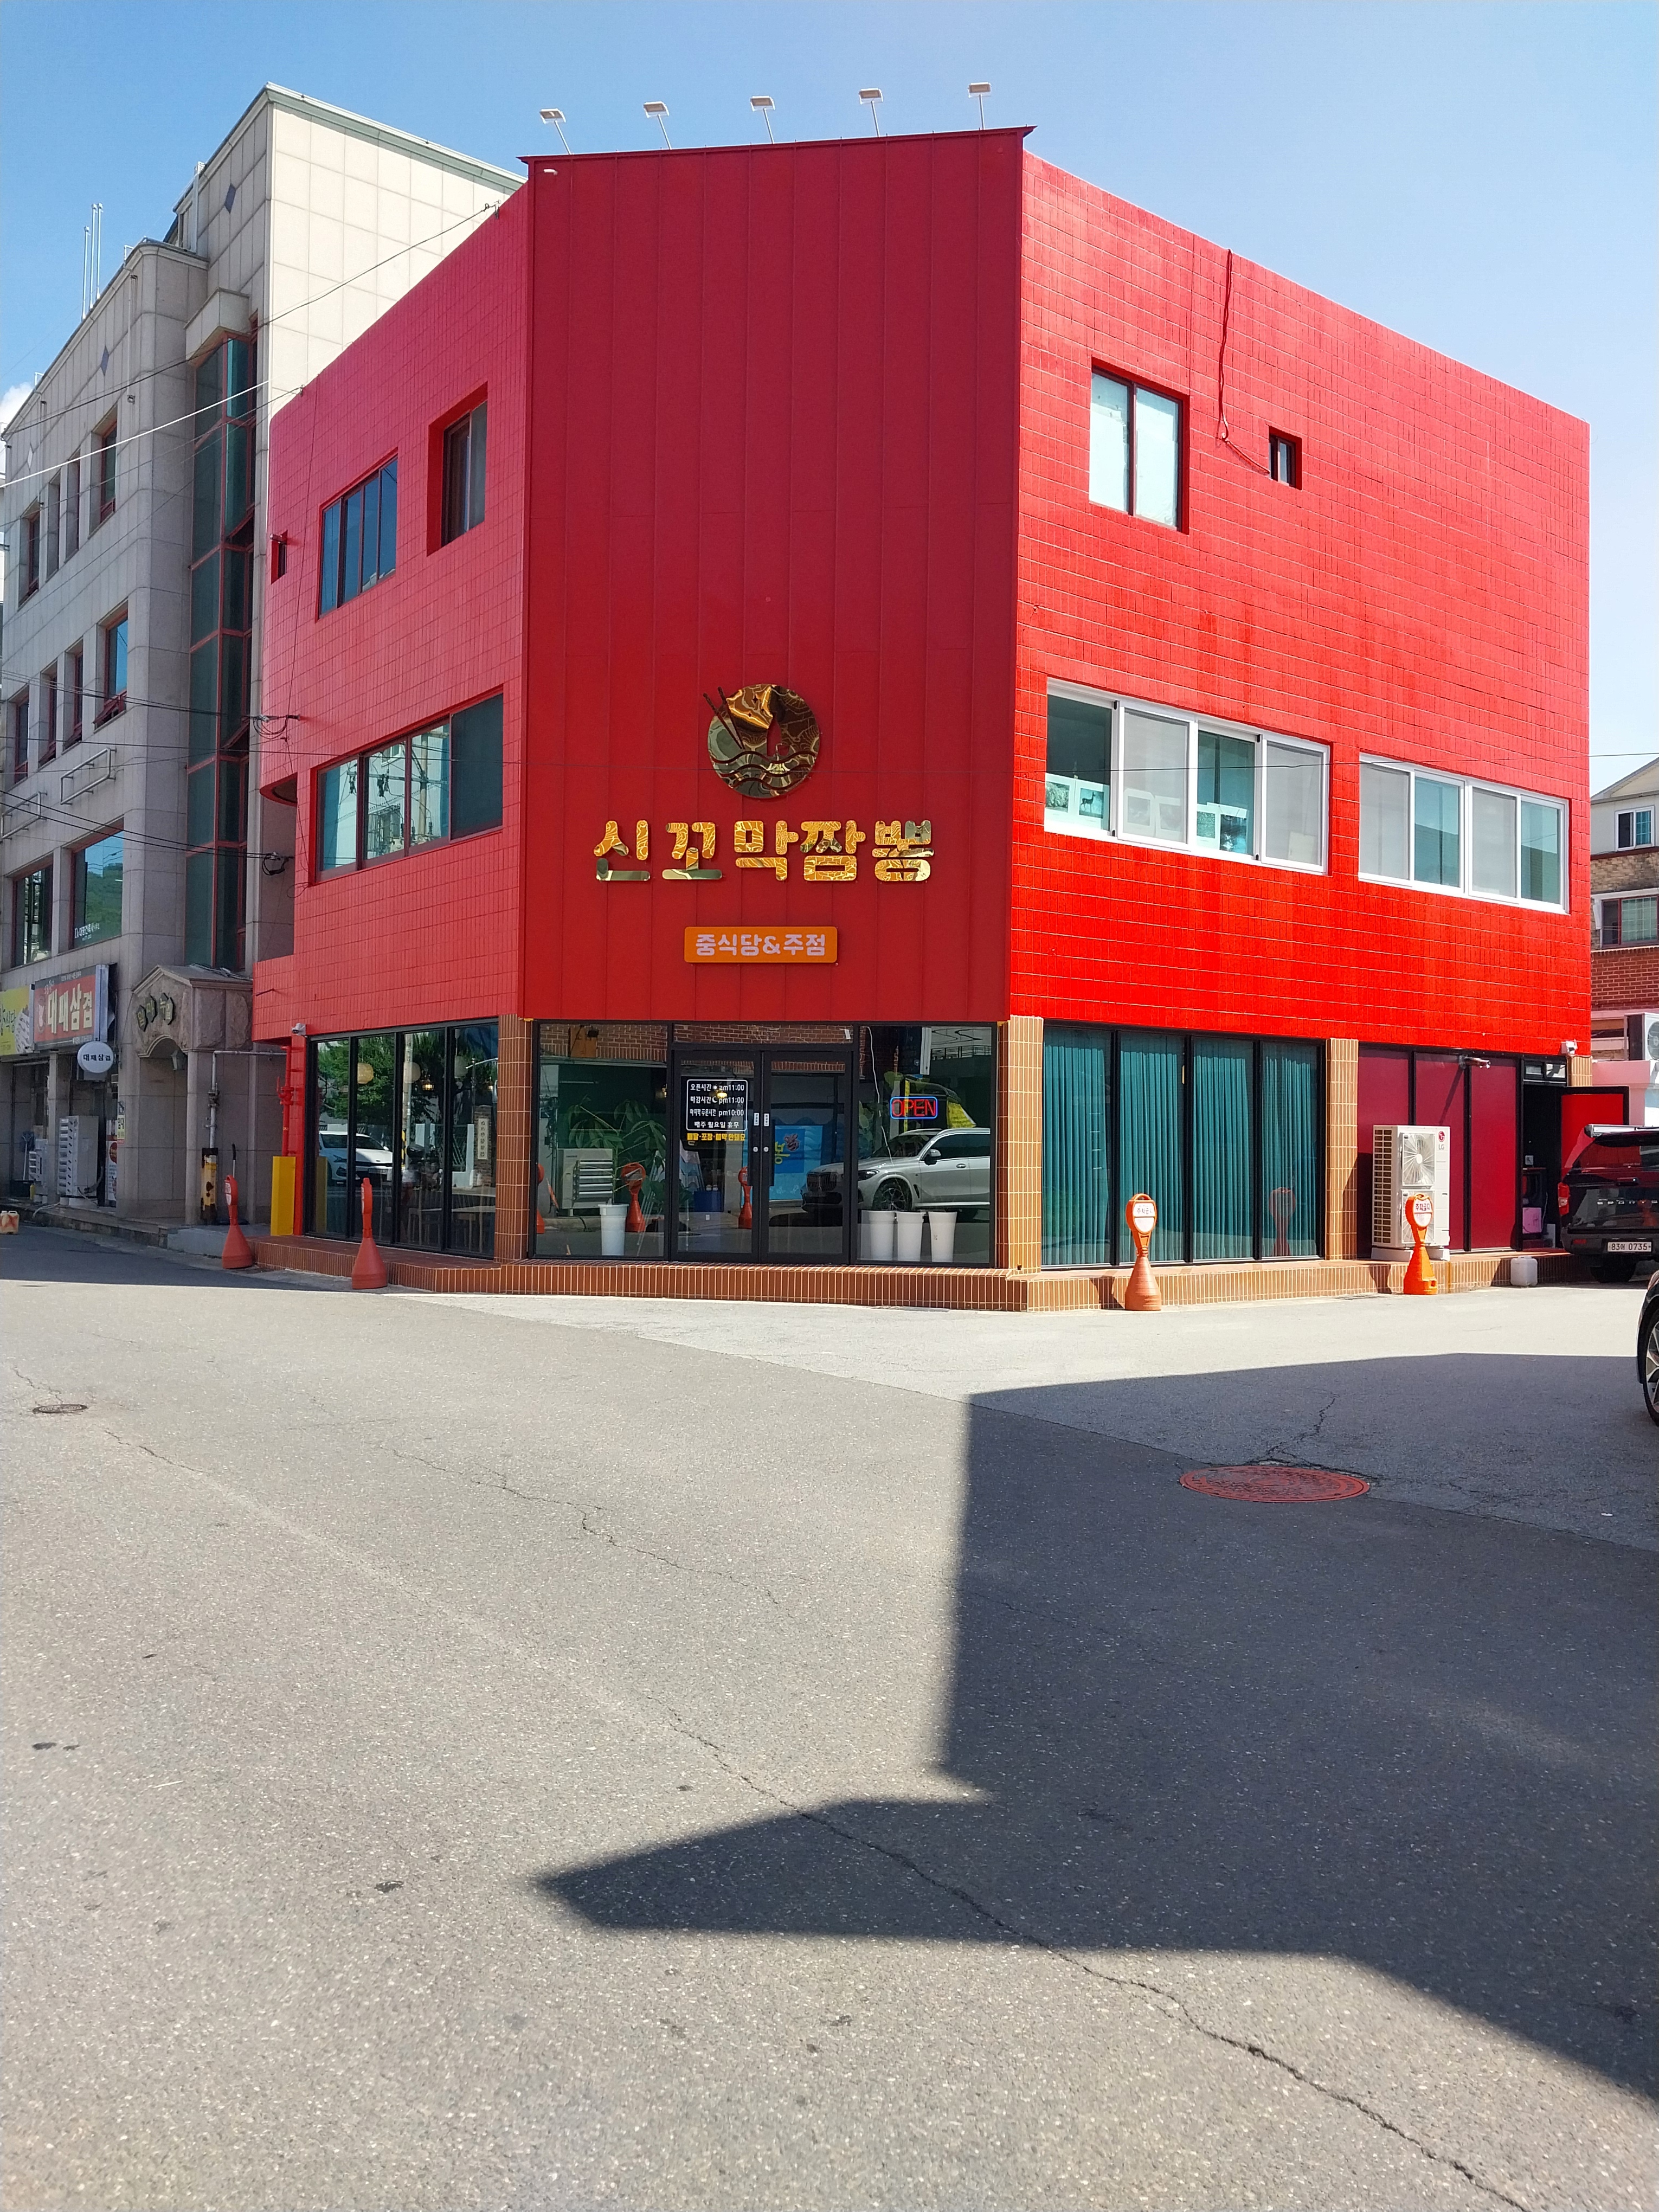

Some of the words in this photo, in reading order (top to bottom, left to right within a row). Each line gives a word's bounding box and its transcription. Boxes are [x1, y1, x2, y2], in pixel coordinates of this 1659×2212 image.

[695, 933, 826, 956] 중식당&주점
[892, 1099, 936, 1116] OPEN
[1416, 1203, 1430, 1211] 주차금지
